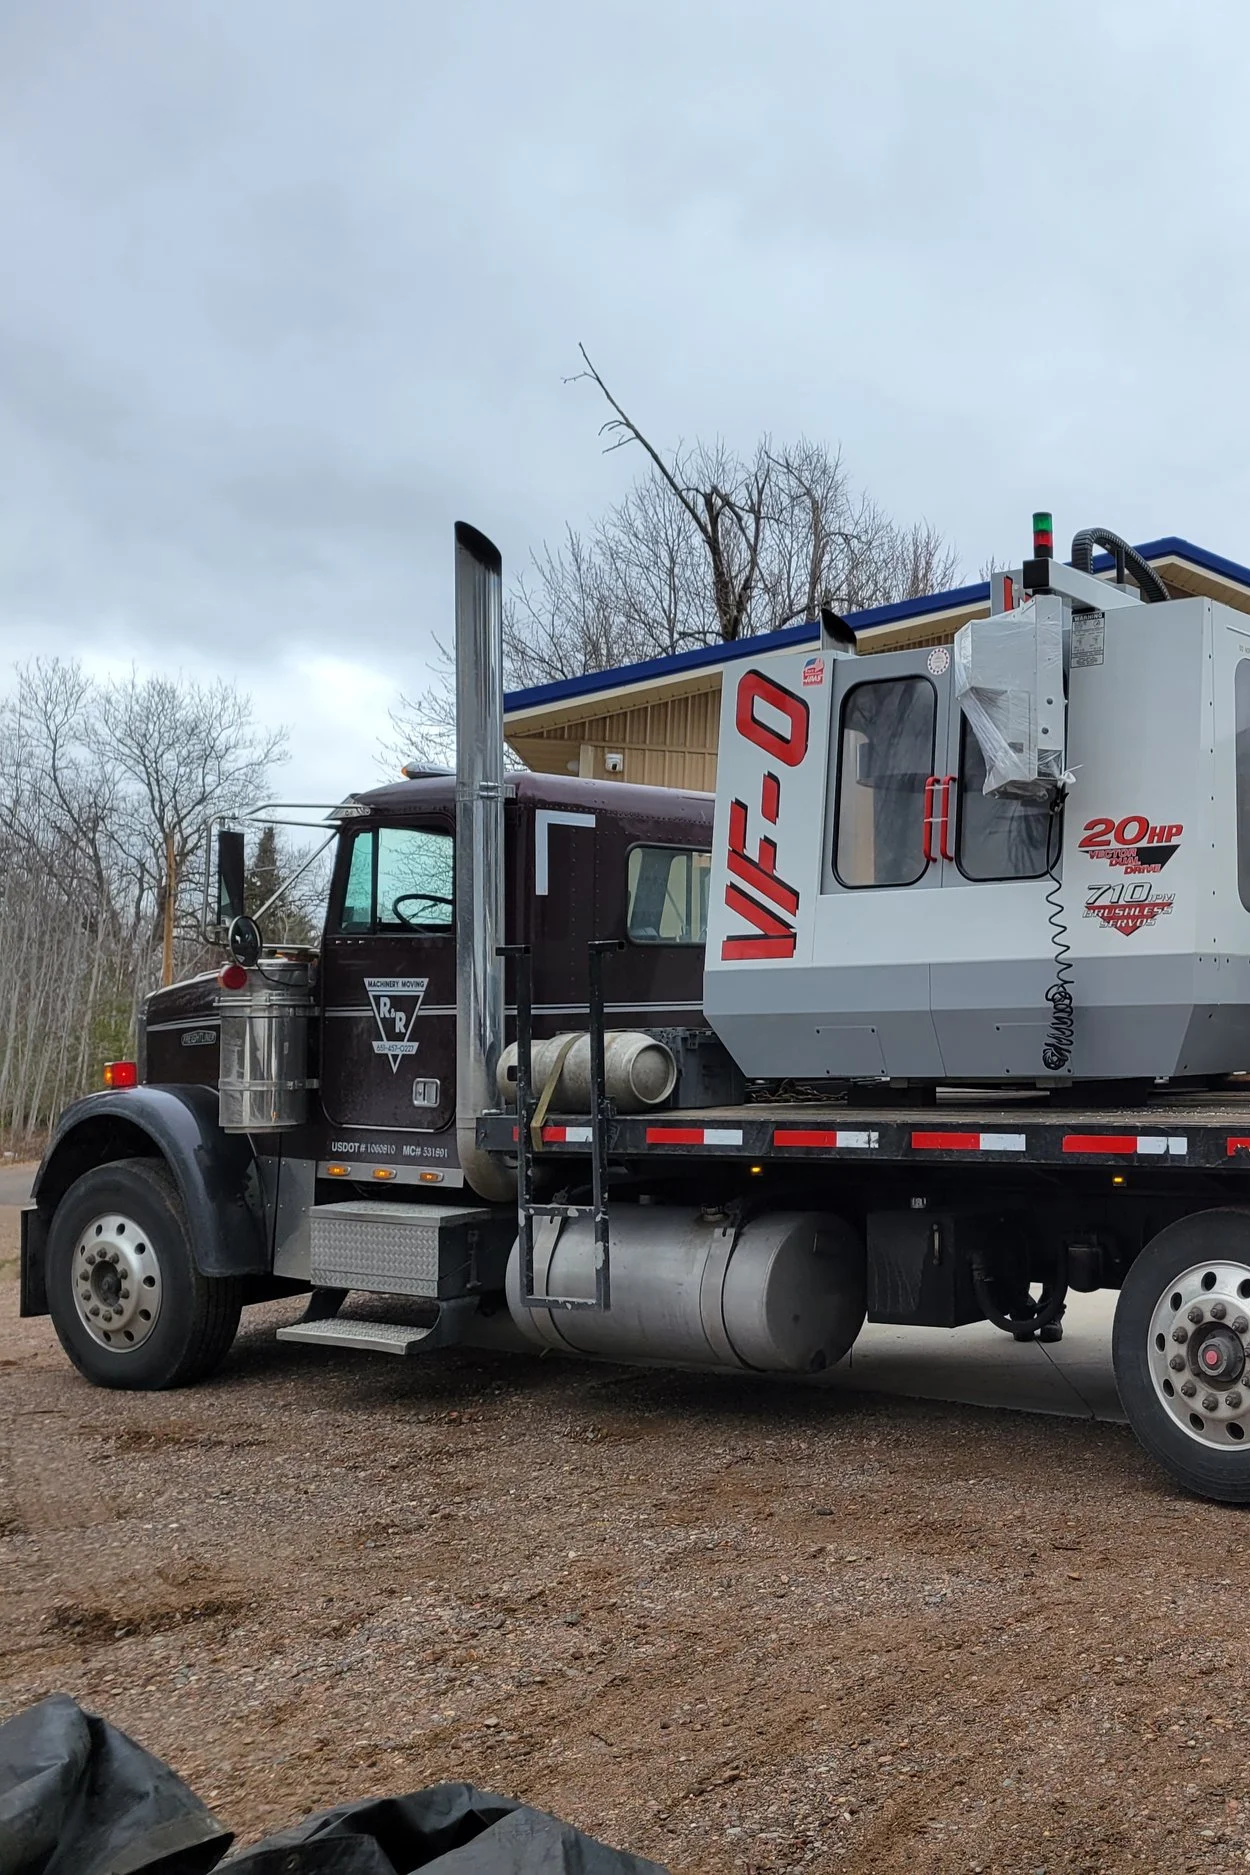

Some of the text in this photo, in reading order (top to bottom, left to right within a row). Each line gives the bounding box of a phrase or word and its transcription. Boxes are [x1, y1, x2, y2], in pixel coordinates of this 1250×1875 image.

[1088, 847, 1138, 859] VECTOR
[1108, 857, 1141, 868] DUAL
[1124, 864, 1161, 875] DRIVE
[1082, 905, 1173, 919] BRUSHLESS
[1099, 918, 1157, 929] SERVOS
[367, 980, 425, 988] MACHINERY MOVING
